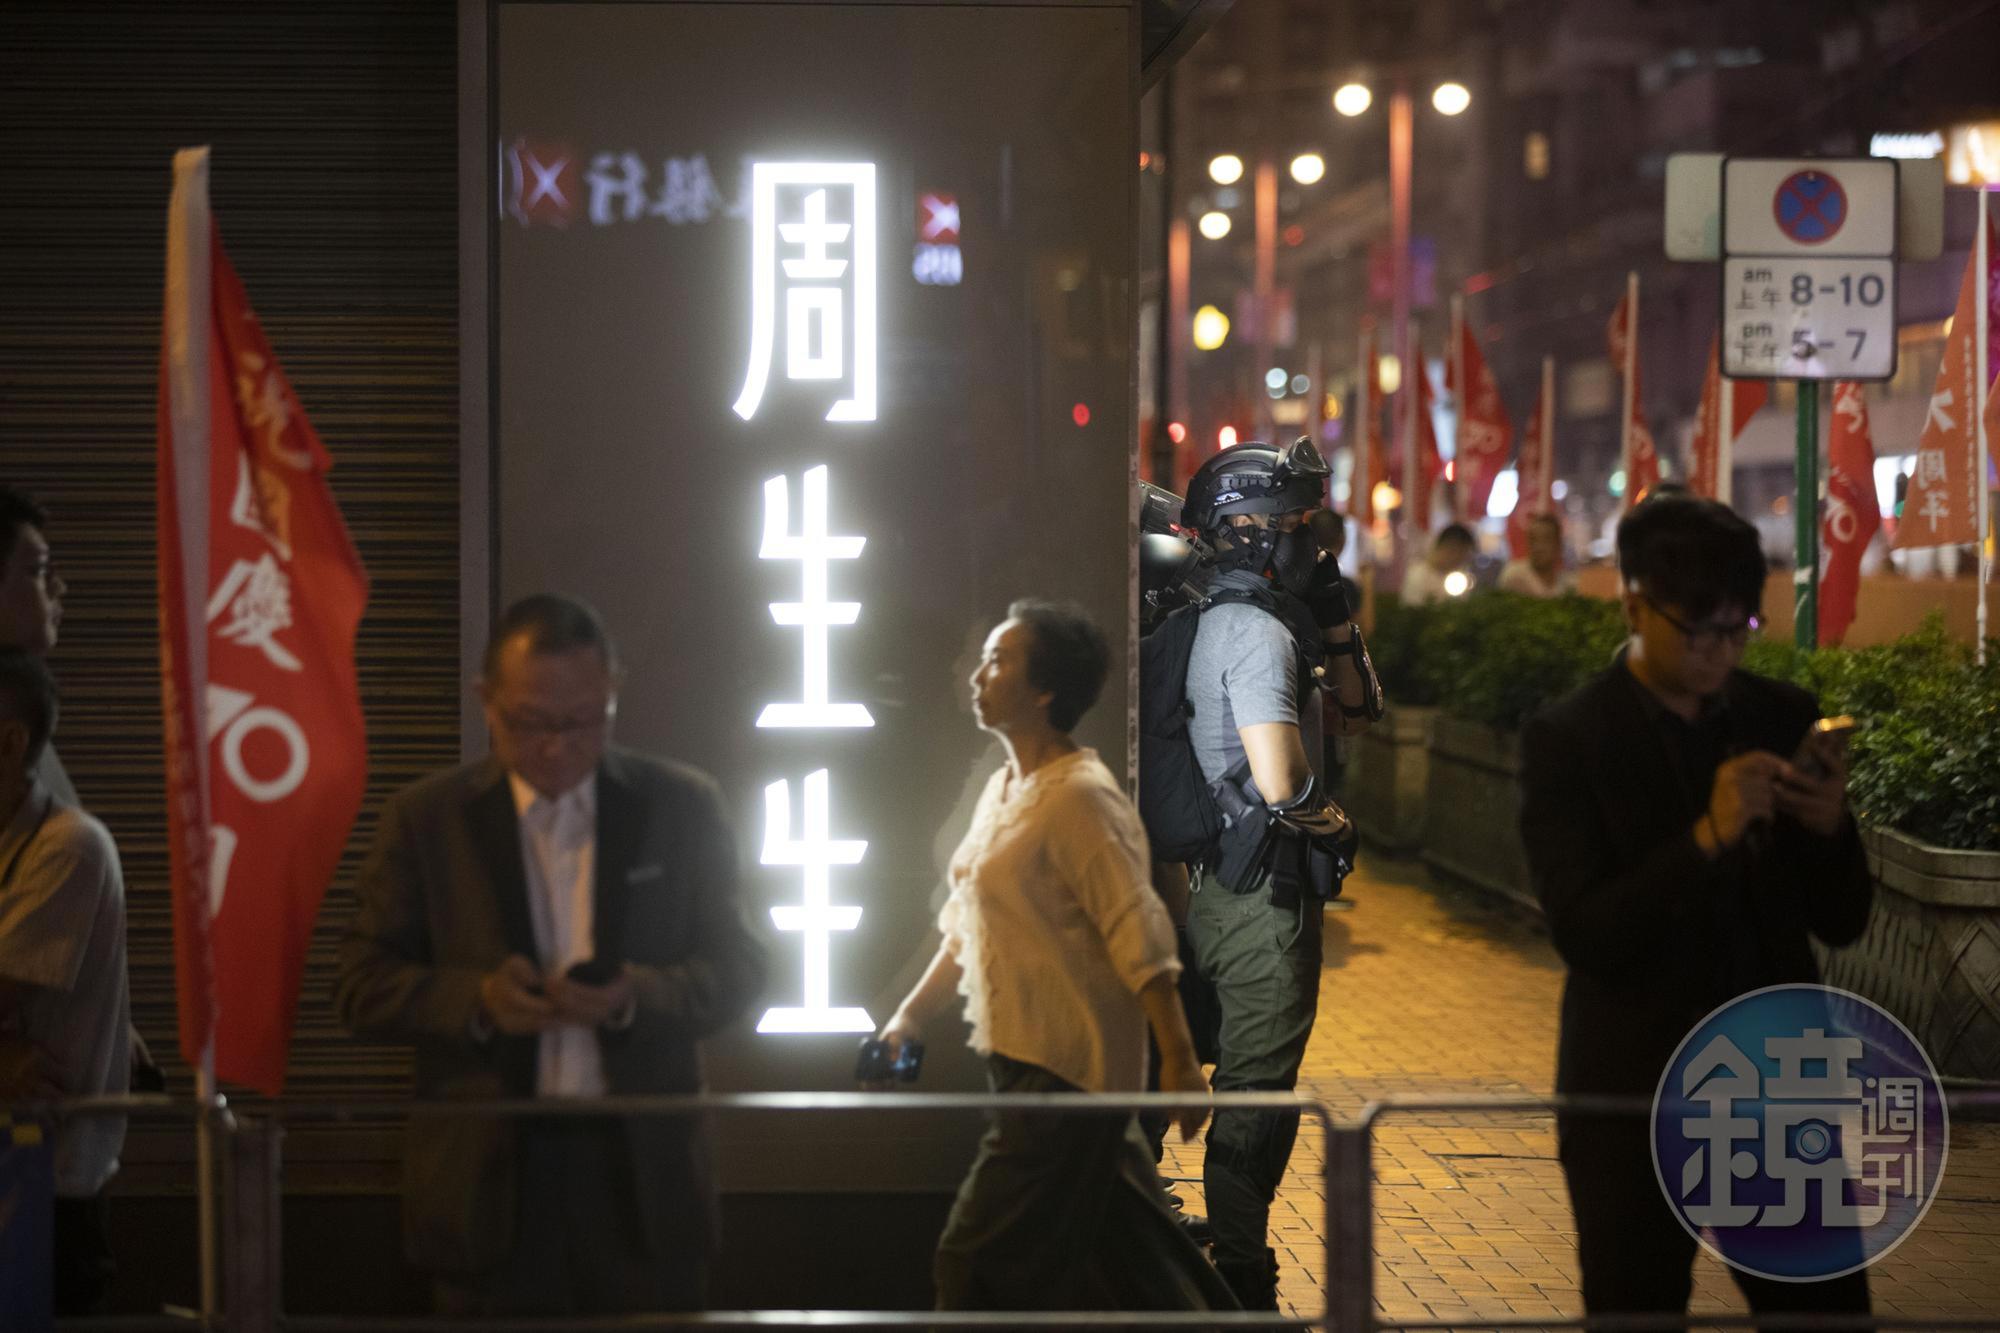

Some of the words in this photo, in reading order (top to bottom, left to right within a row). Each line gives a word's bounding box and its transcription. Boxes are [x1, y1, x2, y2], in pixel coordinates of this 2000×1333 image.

[1743, 267, 1772, 282] am
[1735, 287, 1782, 310] 上午
[1790, 273, 1885, 307] 8-10
[1742, 322, 1772, 338] pm
[1735, 342, 1781, 363] 下午
[732, 161, 878, 1033] 周生生
